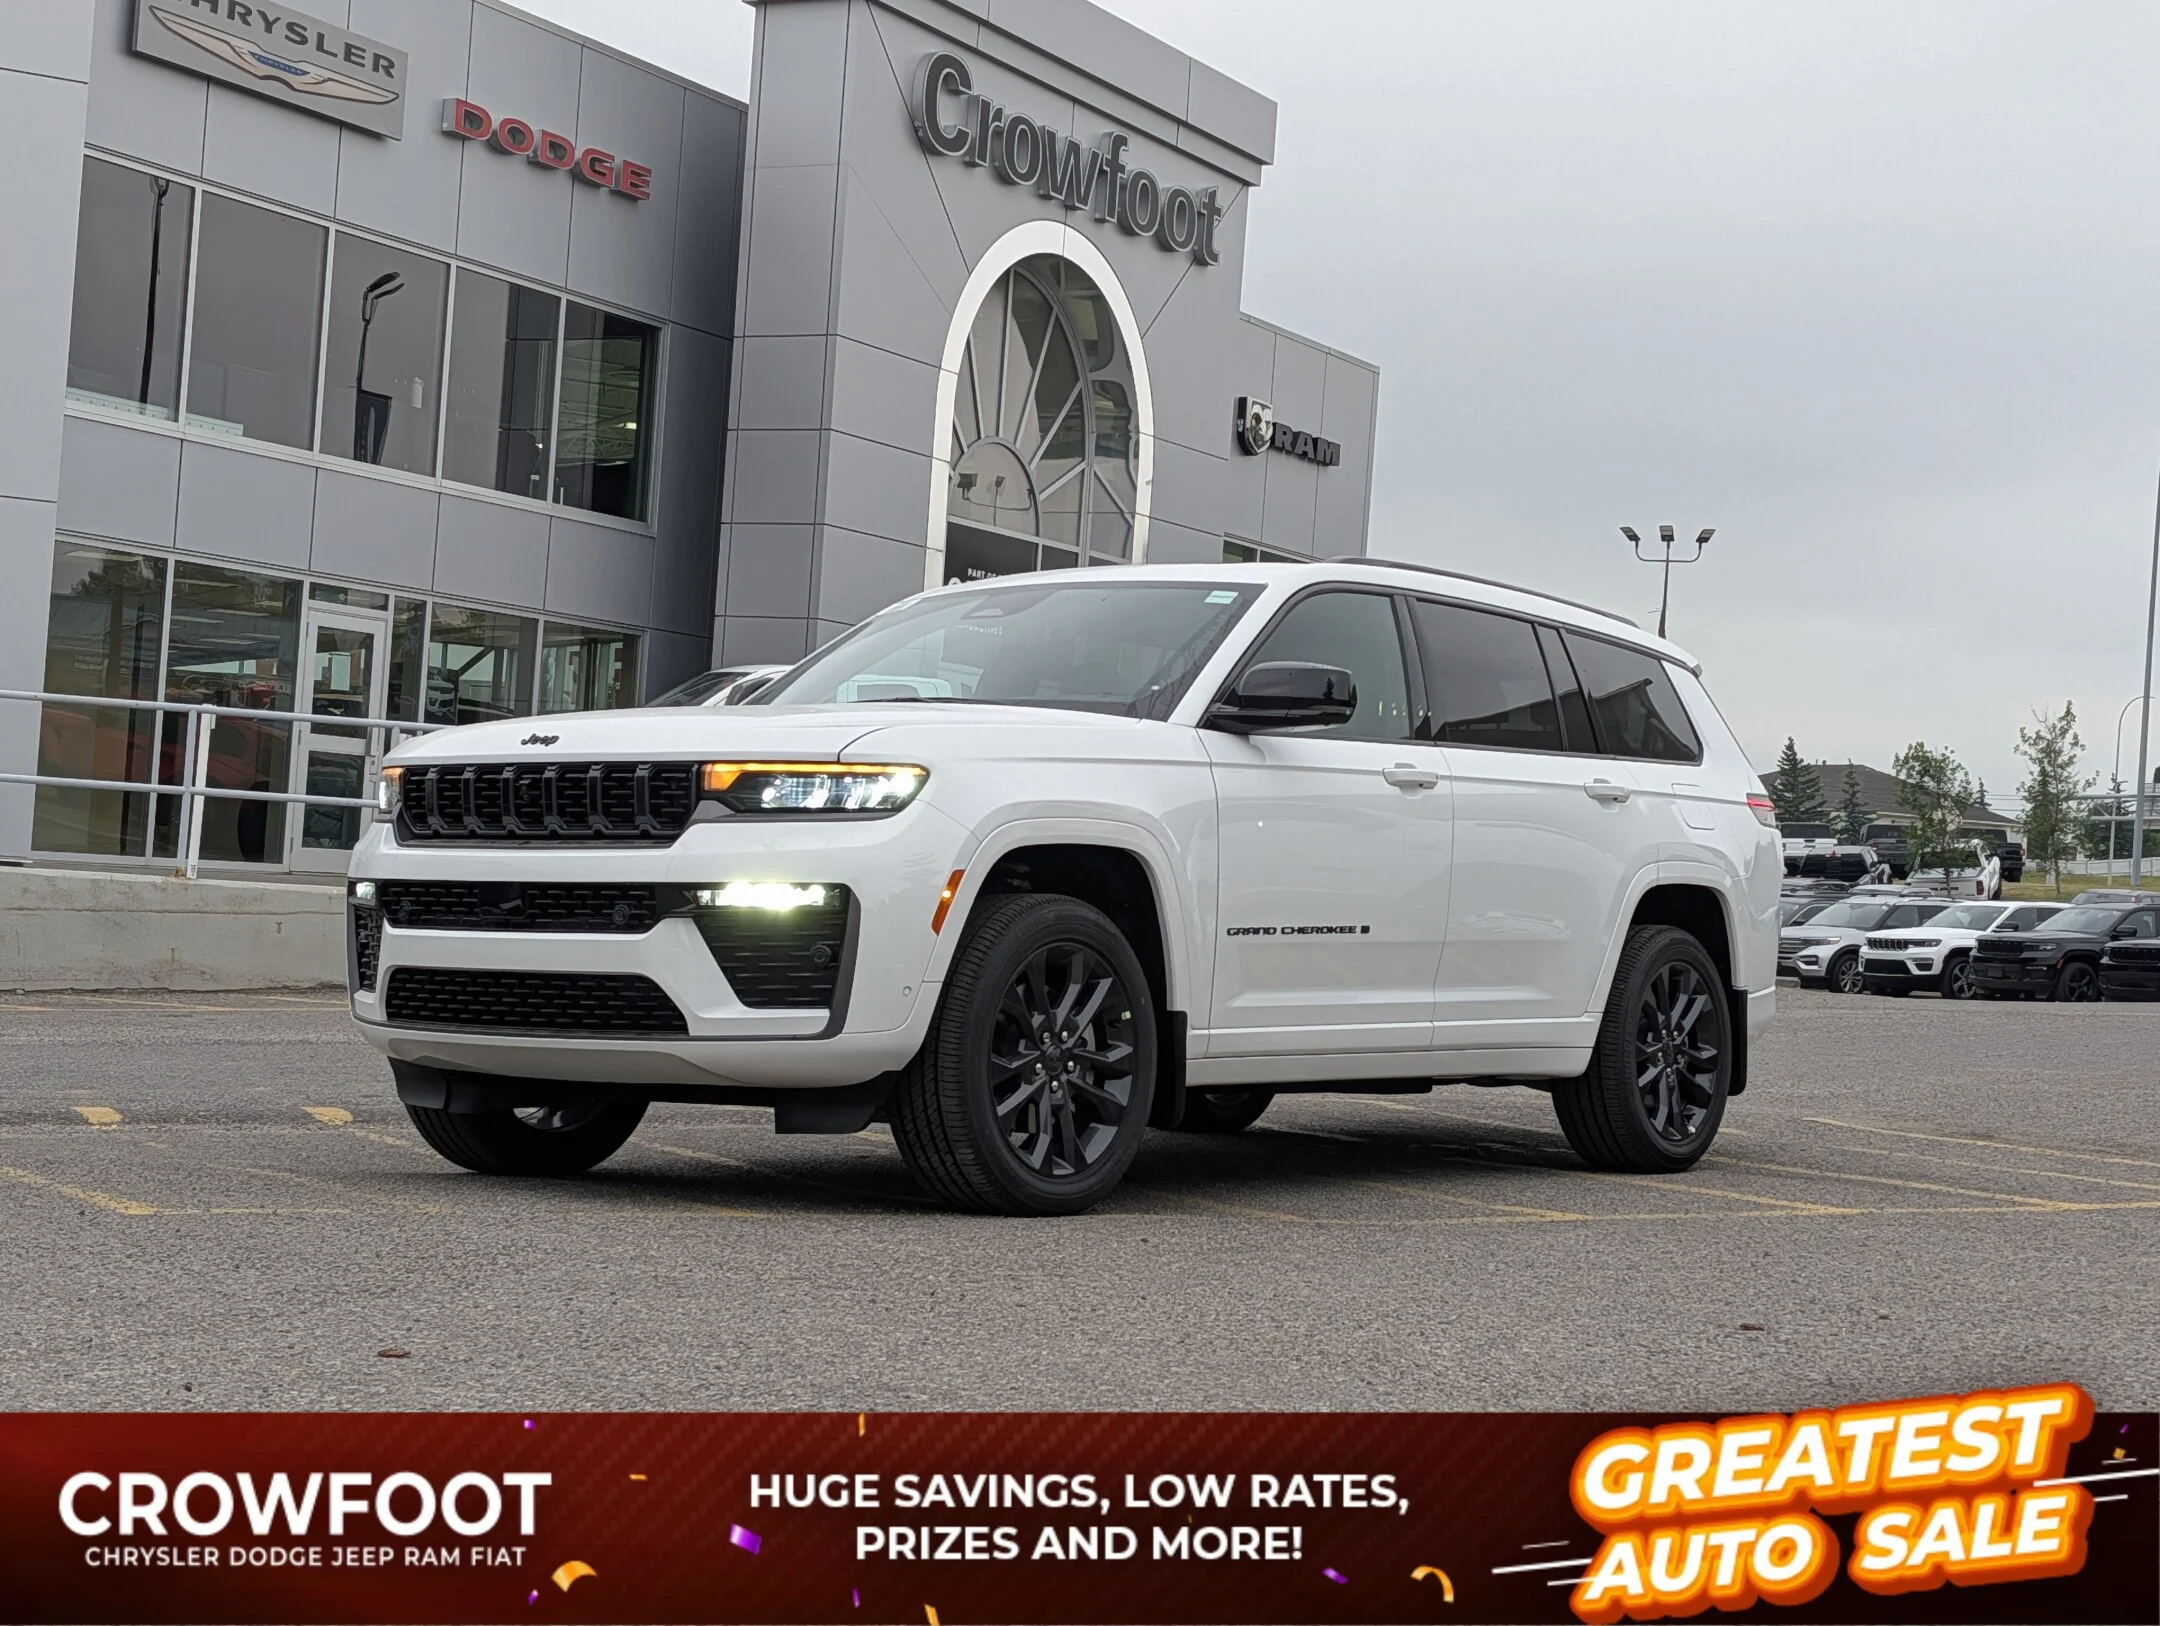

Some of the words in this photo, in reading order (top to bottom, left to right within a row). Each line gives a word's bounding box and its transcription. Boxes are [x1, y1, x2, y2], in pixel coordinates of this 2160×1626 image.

[177, 0, 397, 79] HRYSLER
[445, 97, 652, 200] DODGE
[914, 51, 1224, 266] Crowfoot
[1272, 421, 1341, 467] RAM
[520, 733, 560, 747] Jeep
[1226, 926, 1277, 936] GRAND
[1280, 925, 1357, 935] CHEROKEE
